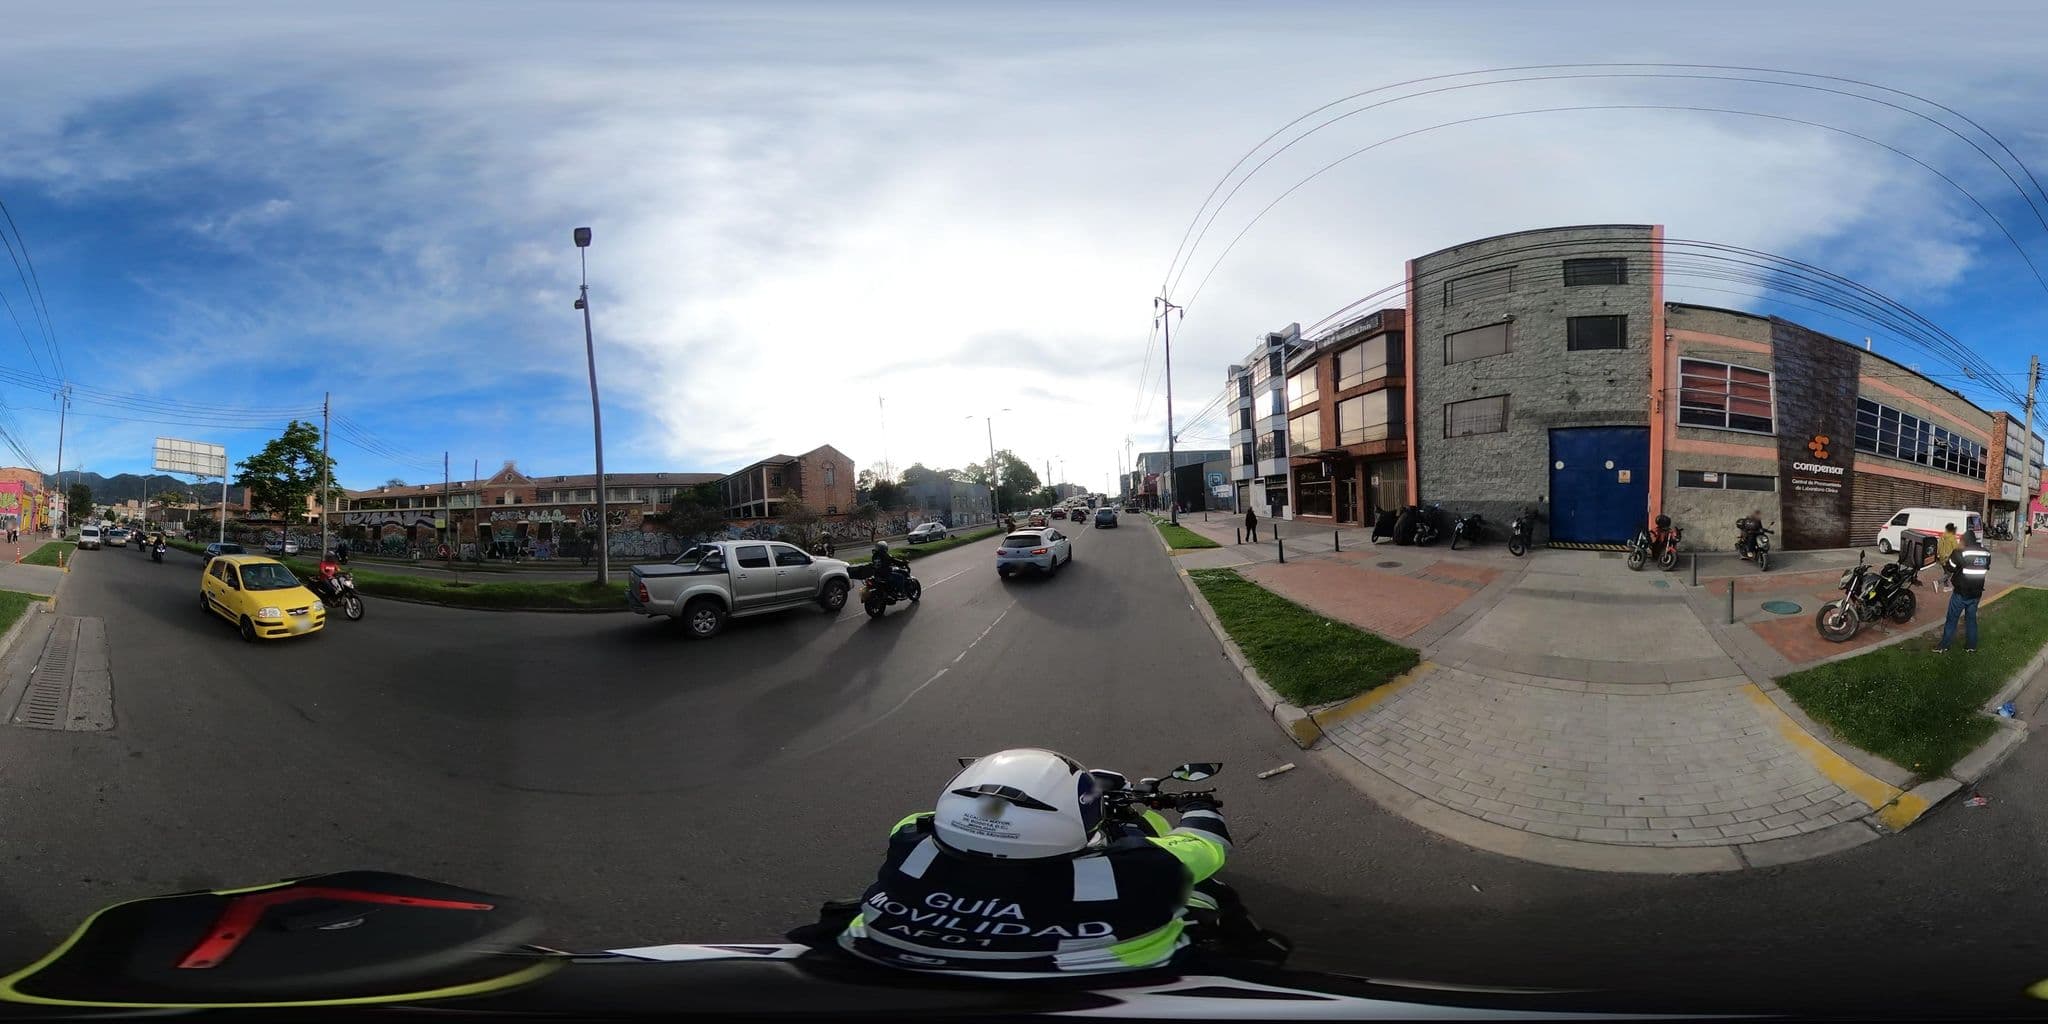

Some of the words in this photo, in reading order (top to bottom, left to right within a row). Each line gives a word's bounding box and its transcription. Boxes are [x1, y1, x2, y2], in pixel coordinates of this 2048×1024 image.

[1793, 462, 1844, 475] compensar
[869, 891, 1114, 937] MOVILIDAD
[925, 892, 1025, 919] GUÍA
